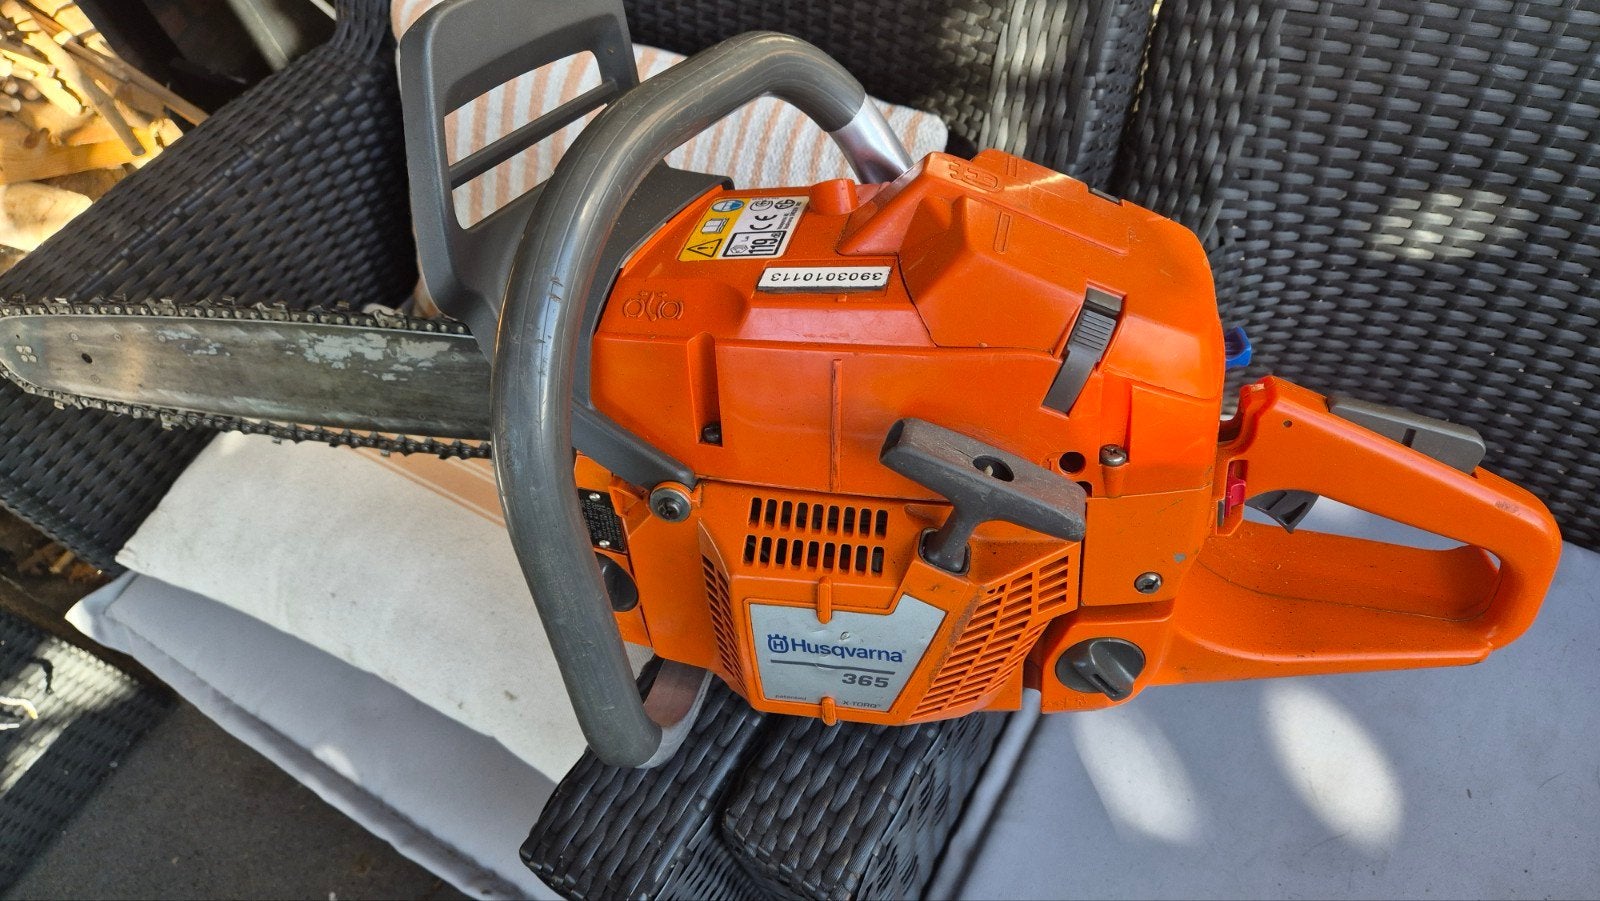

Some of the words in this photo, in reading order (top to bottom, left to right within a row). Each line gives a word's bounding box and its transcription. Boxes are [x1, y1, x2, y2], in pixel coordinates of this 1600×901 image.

[750, 215, 777, 230] CE
[749, 239, 778, 253] 119
[771, 272, 883, 282] 3903010113
[791, 638, 903, 663] Husqvarna
[842, 673, 889, 688] 365
